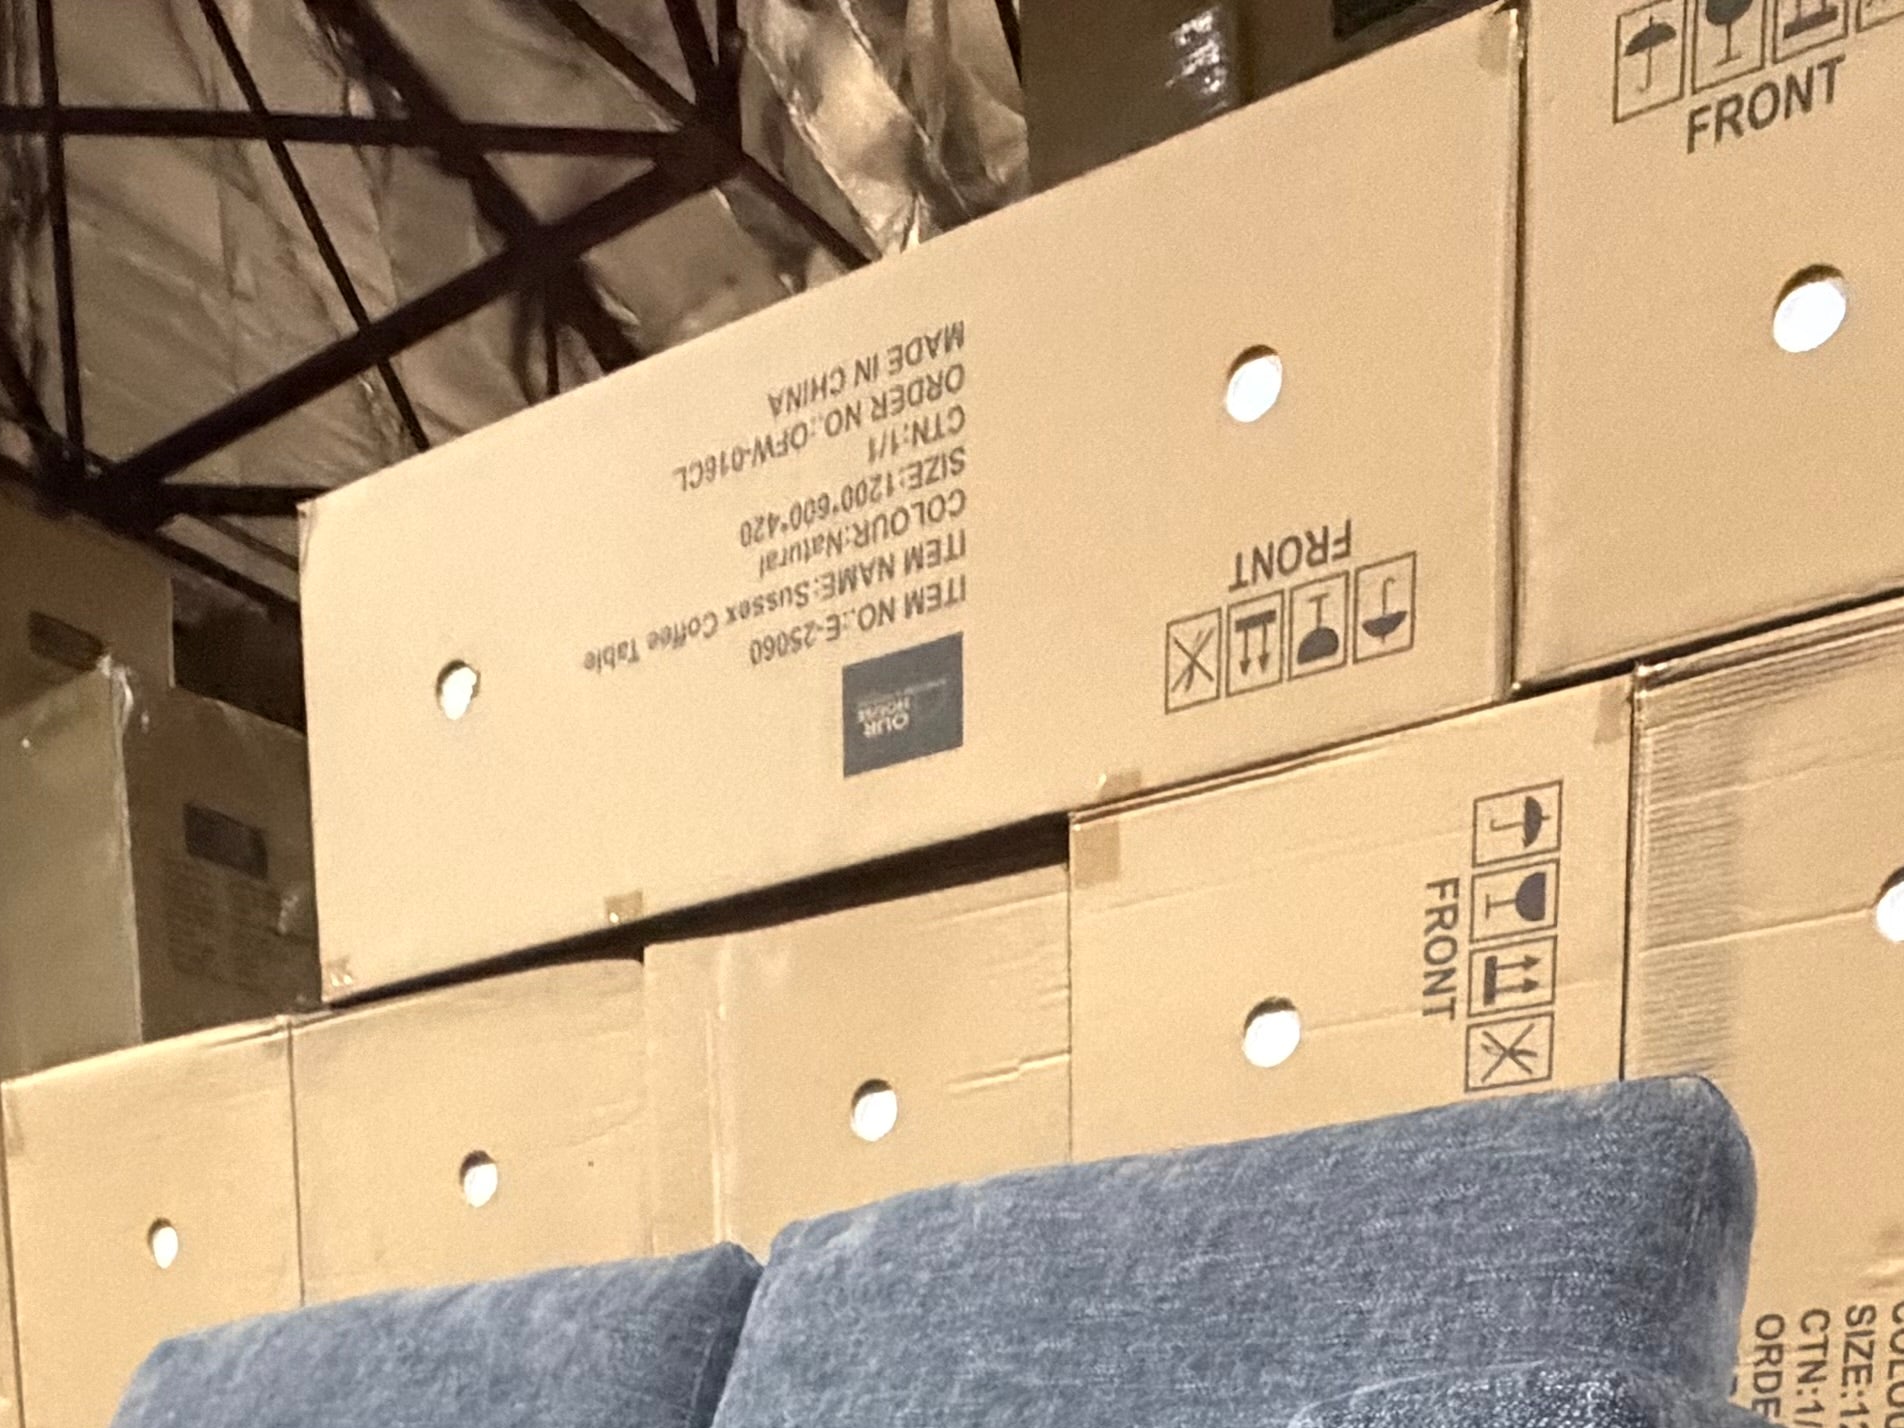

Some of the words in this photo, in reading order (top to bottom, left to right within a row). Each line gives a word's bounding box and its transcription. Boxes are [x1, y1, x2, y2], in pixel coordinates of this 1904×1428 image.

[1686, 56, 1845, 153] FRONT
[855, 358, 880, 388] IN
[888, 320, 965, 373] MADE
[767, 369, 846, 419] CHINA
[872, 363, 965, 420] ORDER
[867, 404, 965, 463] CTN:1/1
[759, 487, 966, 578] COLOUR:Natural
[904, 529, 966, 576] ITEM
[1228, 519, 1352, 592] FRONT
[725, 550, 895, 624] NAME:Sussex
[904, 574, 966, 621] ITEM
[583, 637, 640, 675] Table
[647, 606, 719, 652] Coffee
[862, 711, 909, 739] OUR
[1422, 876, 1460, 1021] FRONT
[1752, 1312, 1785, 1420] ORDE
